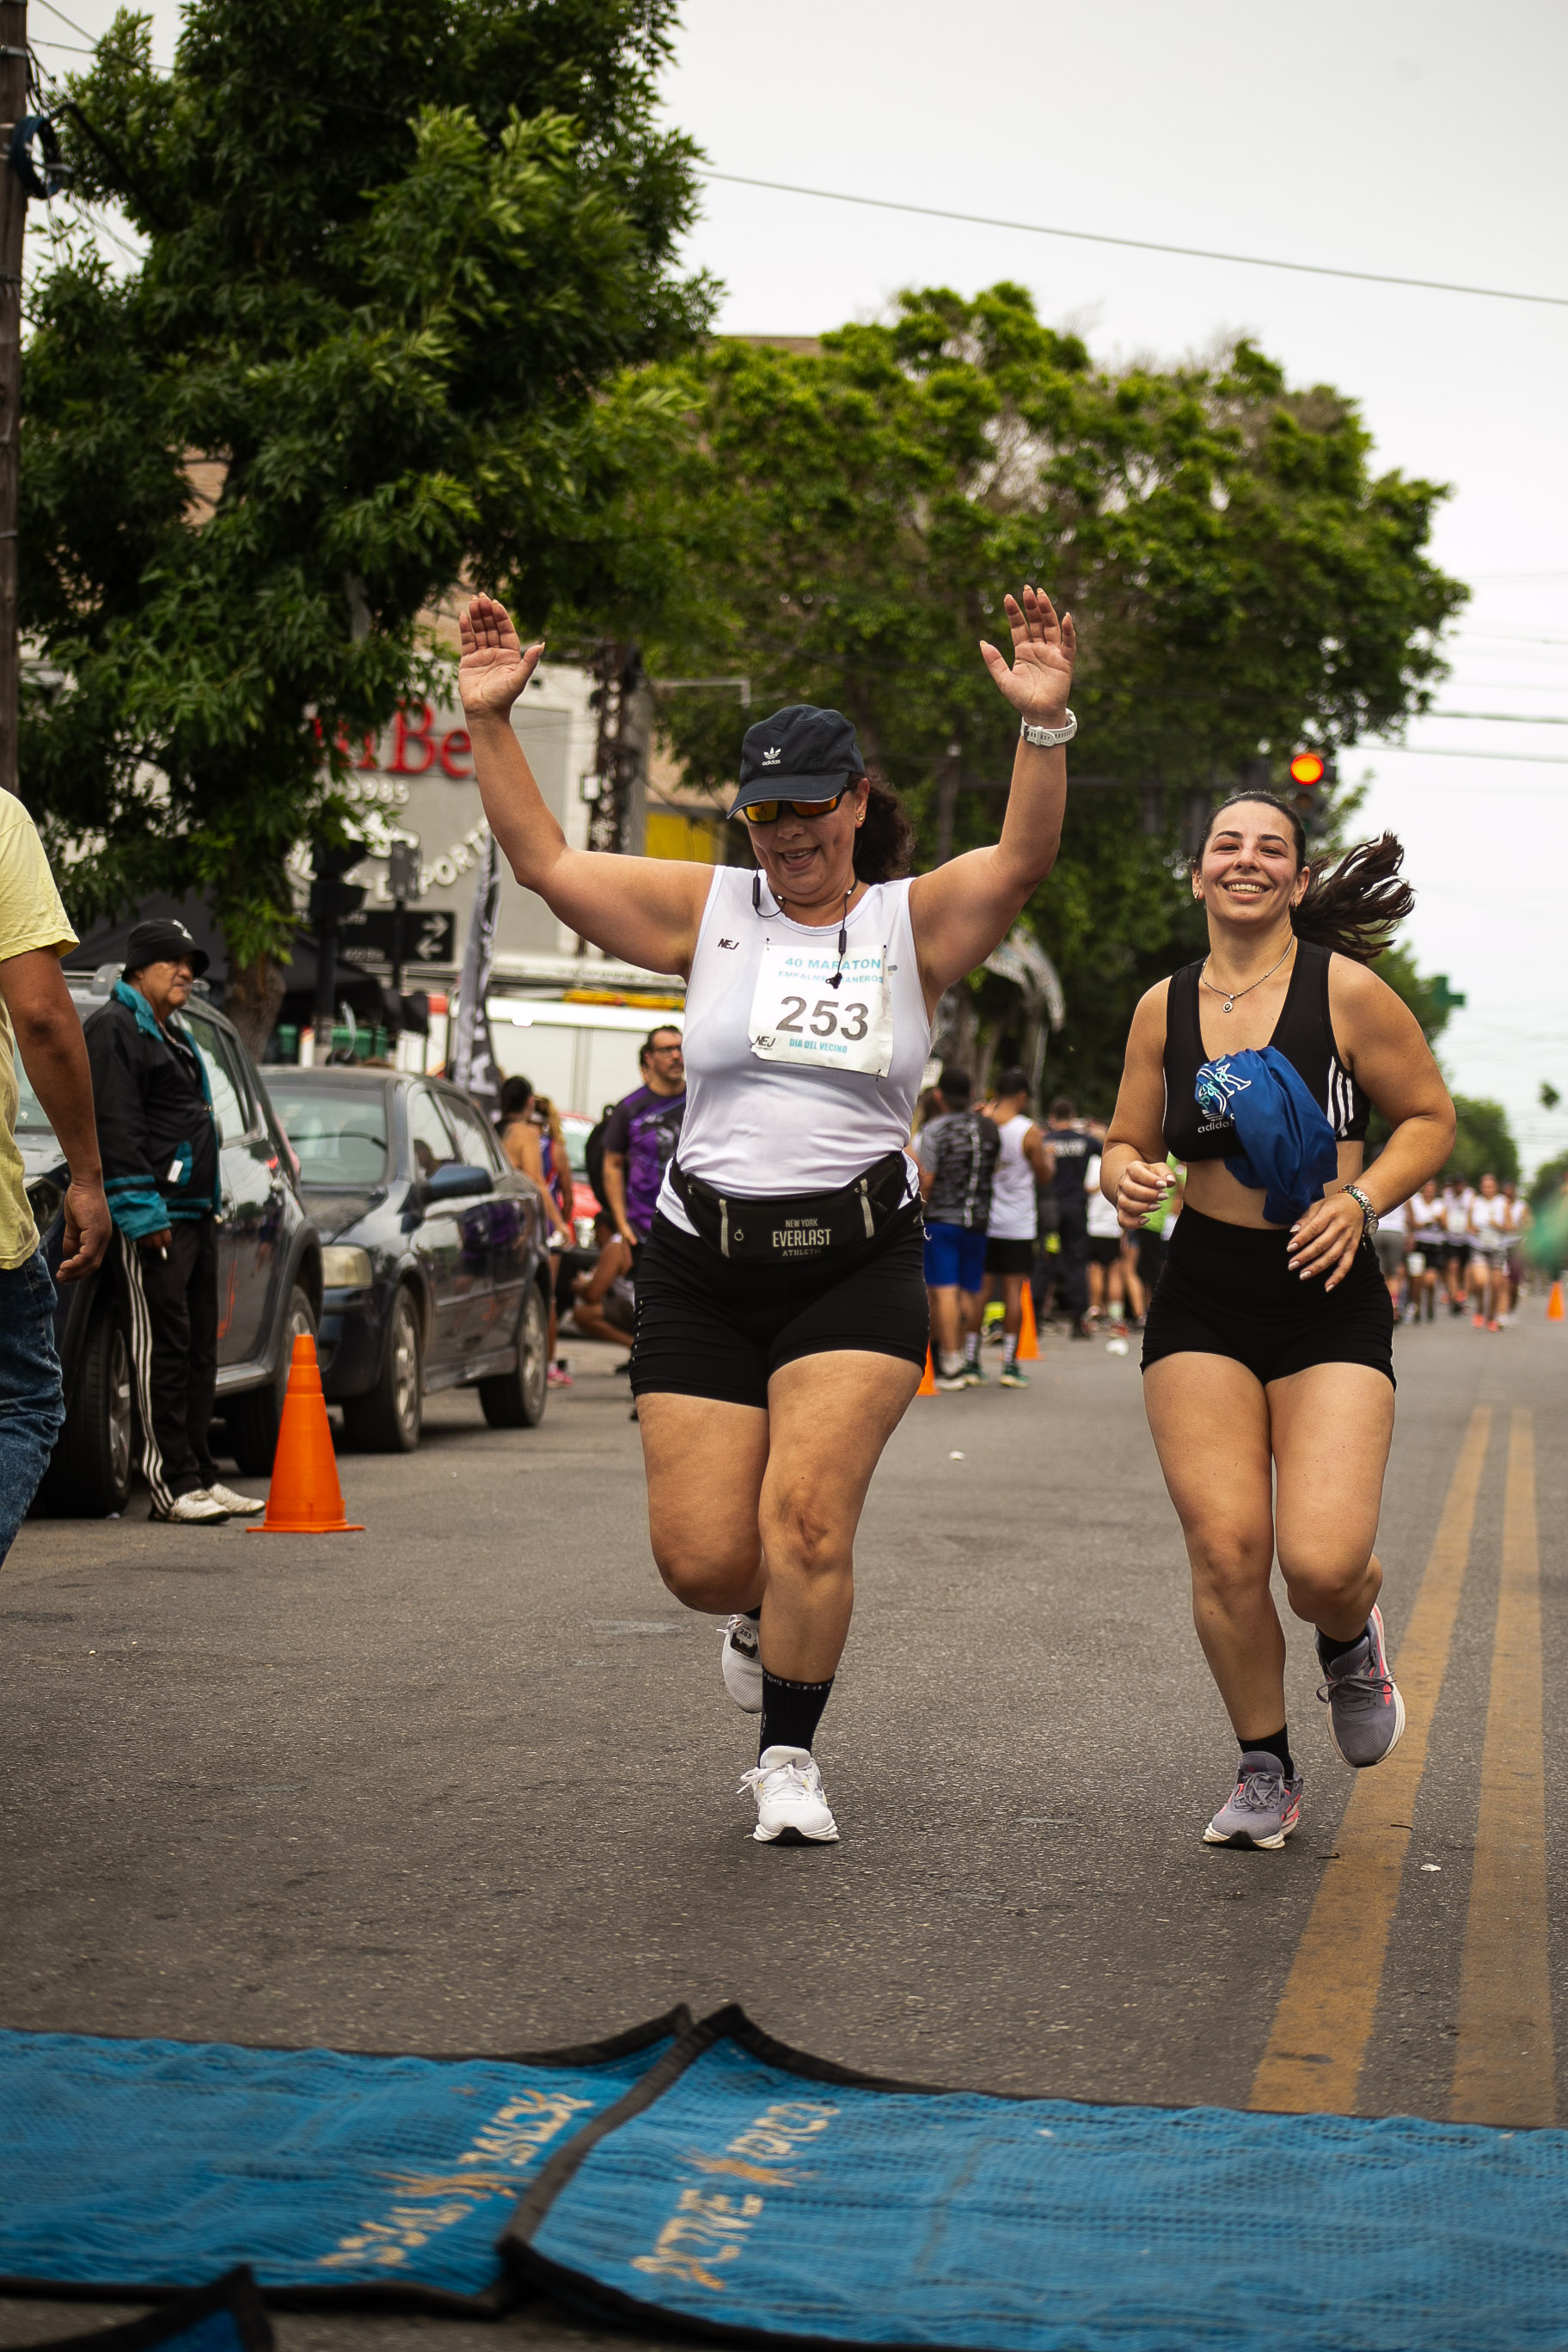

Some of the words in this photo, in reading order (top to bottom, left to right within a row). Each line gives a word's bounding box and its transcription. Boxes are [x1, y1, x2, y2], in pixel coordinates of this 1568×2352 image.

[718, 938, 740, 951] NEJ
[785, 957, 803, 968] 40
[808, 959, 882, 970] MARATON
[842, 974, 885, 984] ANEROS
[775, 995, 869, 1041] 253
[752, 1035, 776, 1048] NEJ
[788, 1038, 803, 1048] DIA
[804, 1040, 818, 1050] DEL
[819, 1042, 848, 1054] VECINO
[785, 1219, 800, 1228] NEW
[800, 1218, 818, 1228] YORK
[773, 1228, 832, 1247] EVERLAST
[738, 1627, 753, 1639] 253
